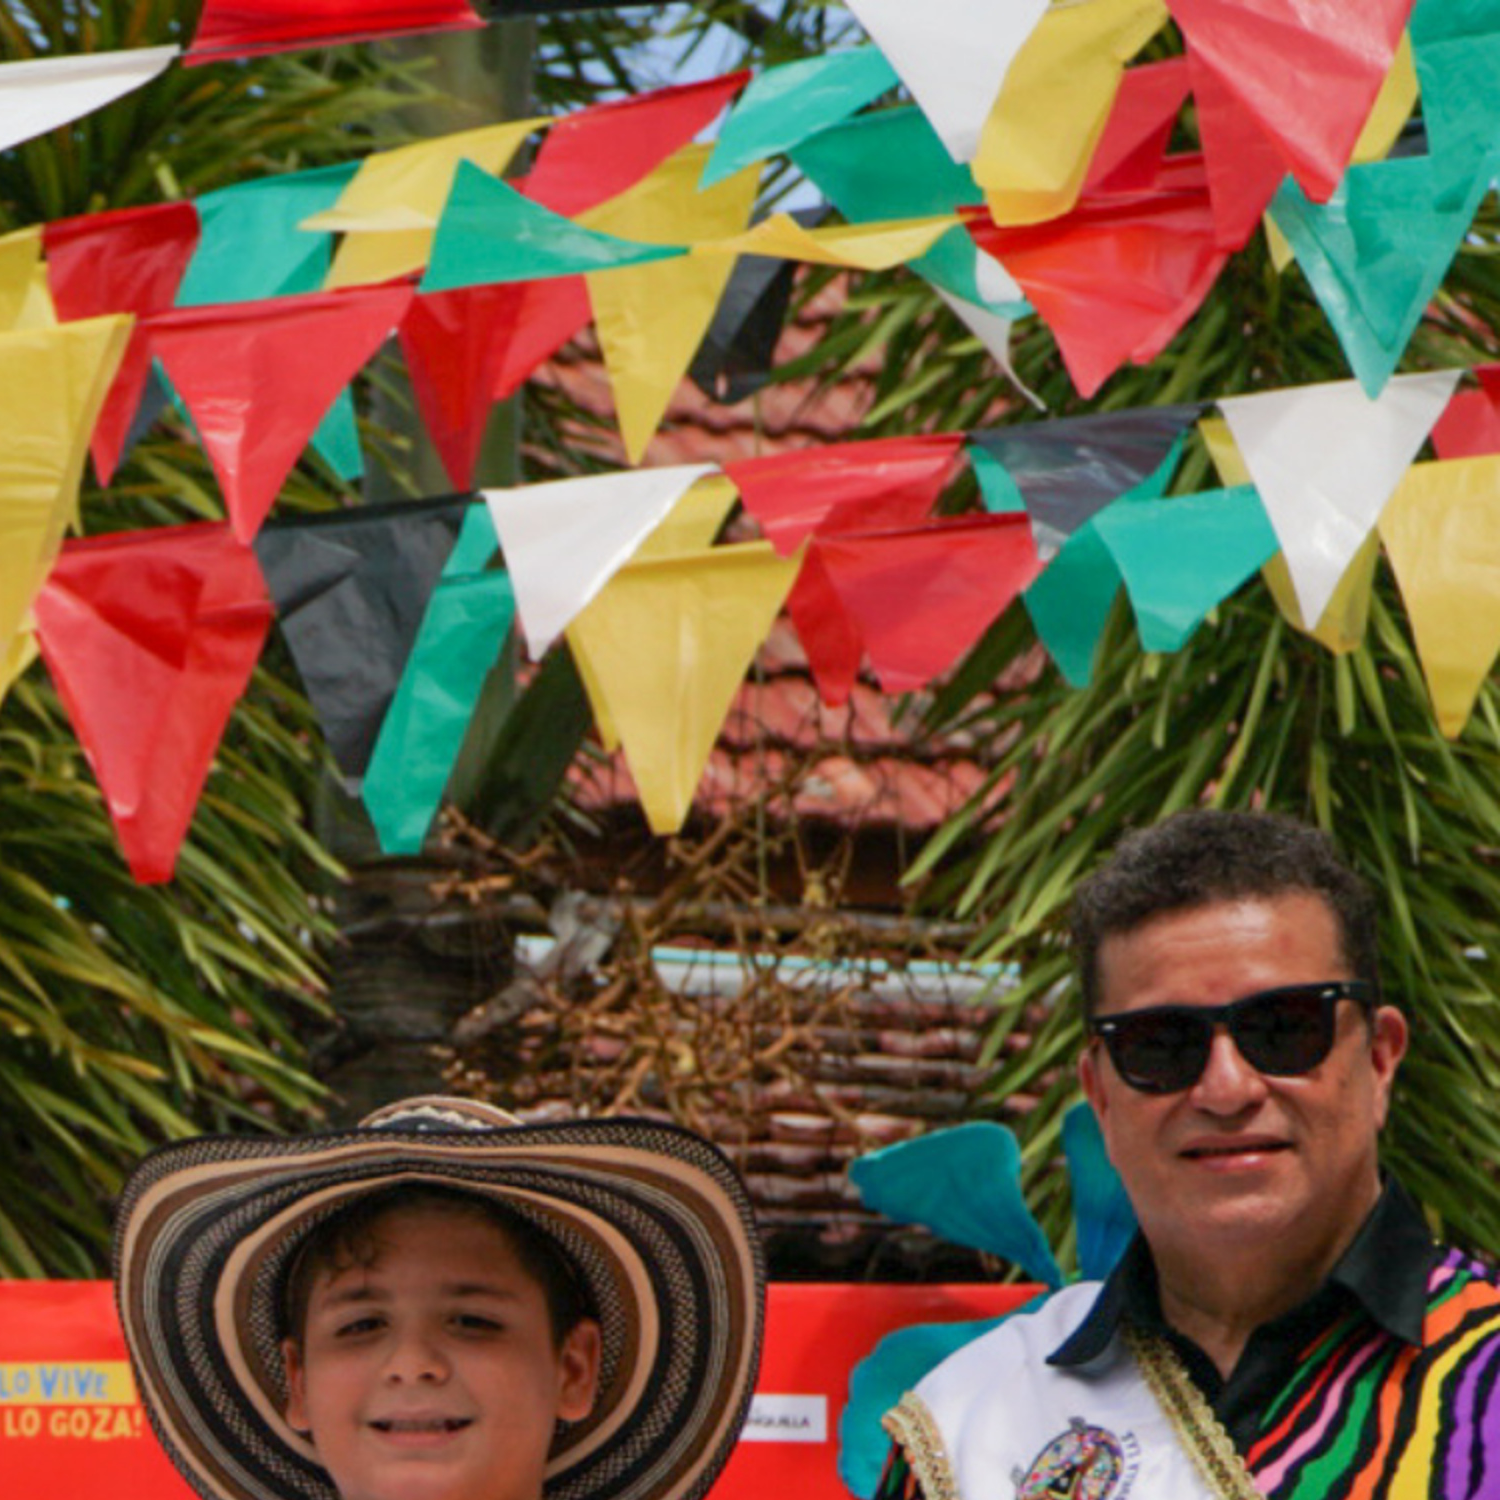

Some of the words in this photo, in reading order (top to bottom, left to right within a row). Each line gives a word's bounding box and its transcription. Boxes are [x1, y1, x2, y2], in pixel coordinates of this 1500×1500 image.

[39, 1365, 108, 1400] VIVE
[5, 1408, 41, 1438] LO
[50, 1408, 142, 1441] GOZA!
